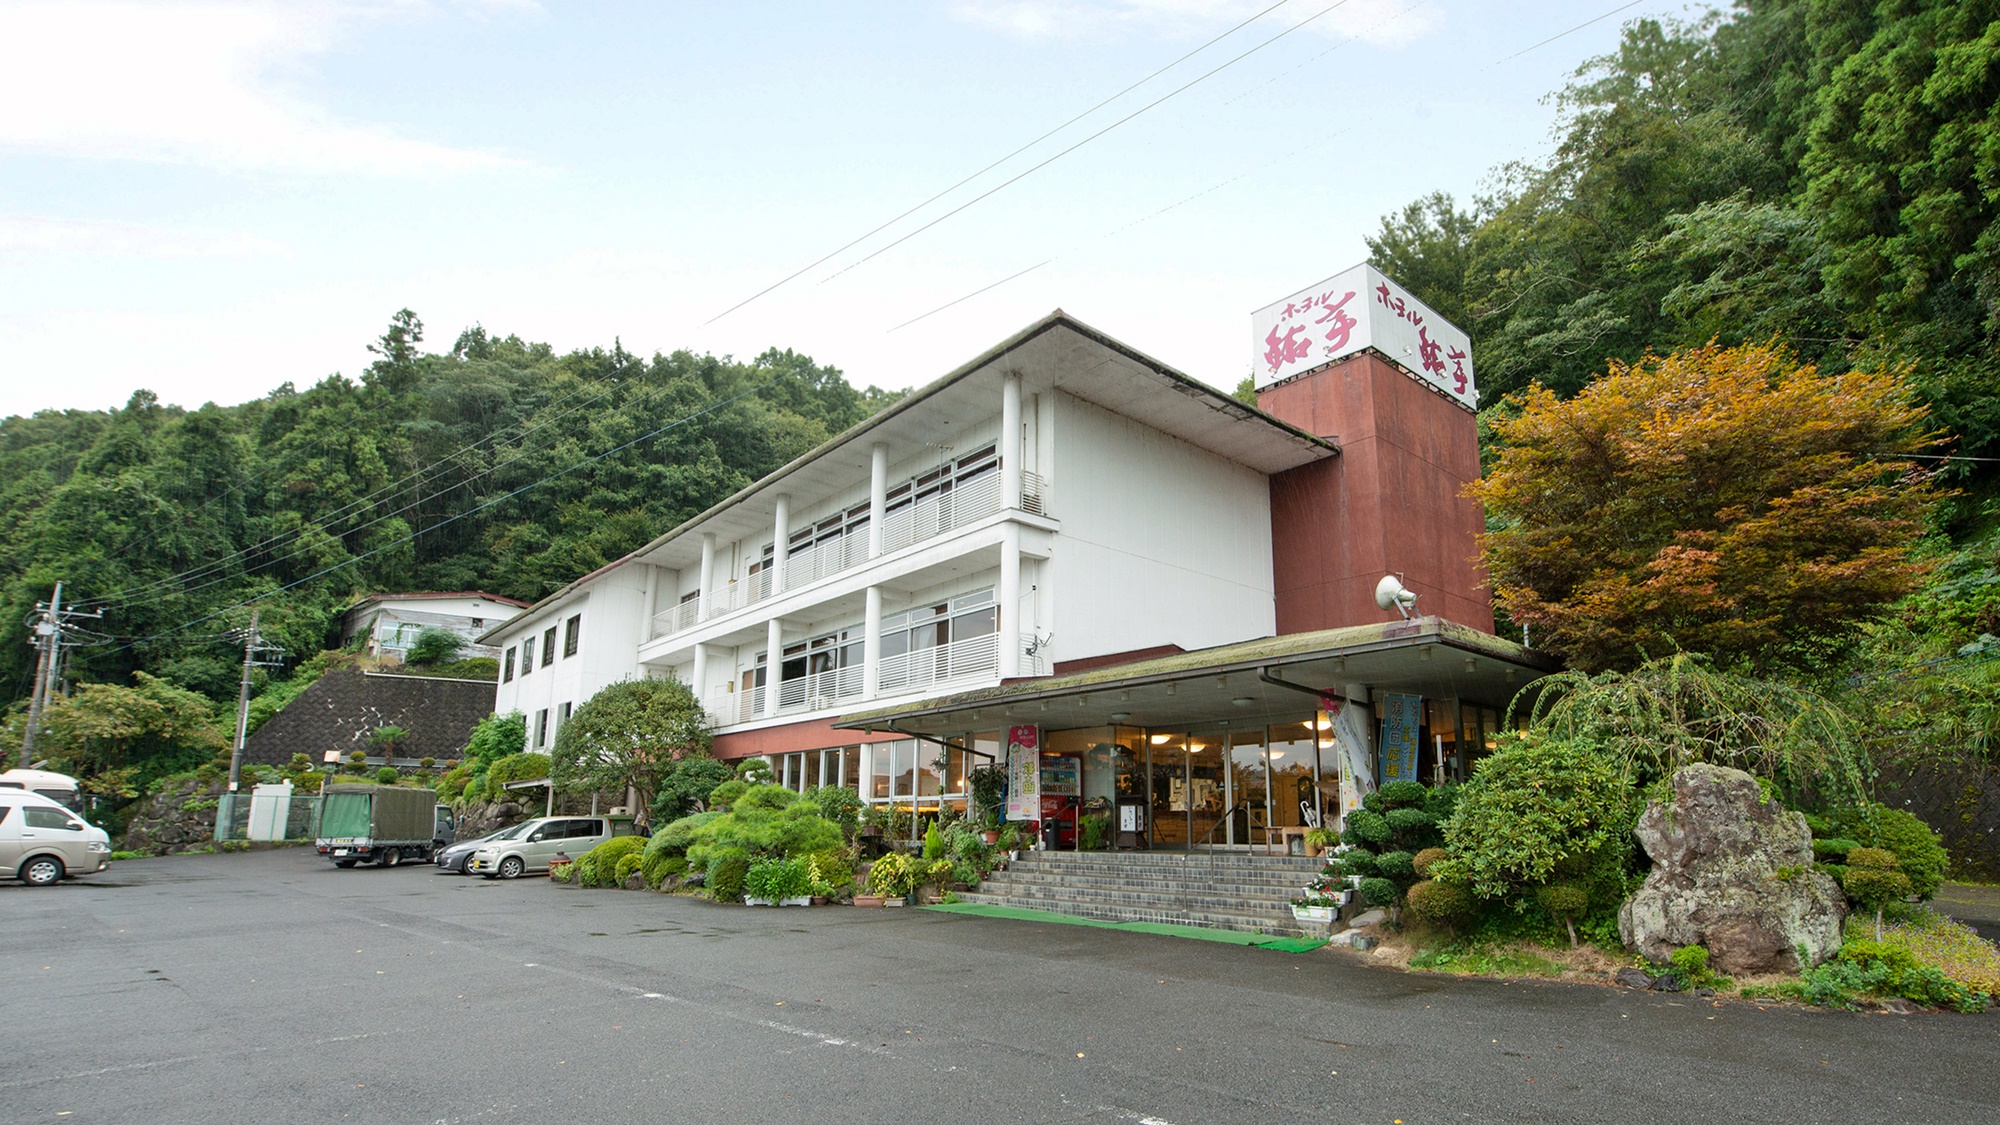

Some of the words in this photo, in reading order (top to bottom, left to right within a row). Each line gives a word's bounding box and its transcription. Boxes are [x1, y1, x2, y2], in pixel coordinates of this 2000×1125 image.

[1280, 290, 1334, 322] ホテル
[1376, 281, 1423, 327] ホテル
